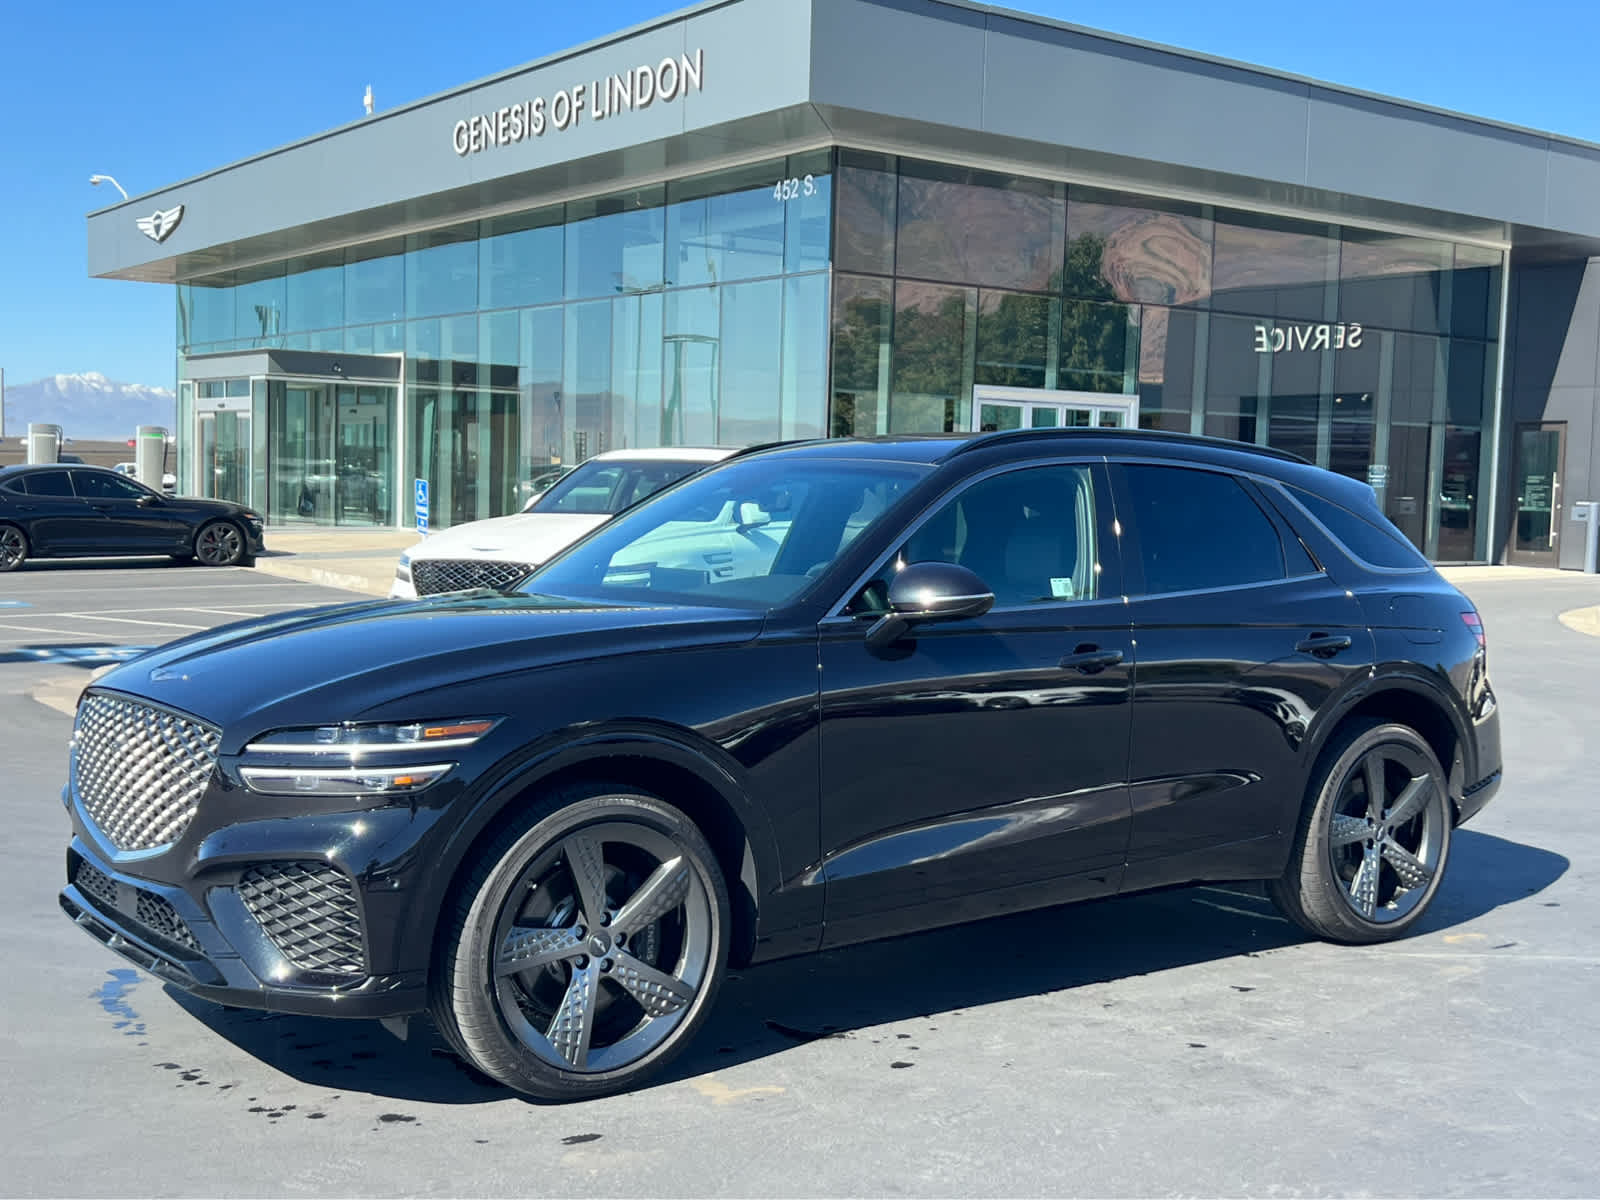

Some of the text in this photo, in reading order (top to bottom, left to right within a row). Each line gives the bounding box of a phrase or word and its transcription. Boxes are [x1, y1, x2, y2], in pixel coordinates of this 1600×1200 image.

[453, 48, 703, 156] GENESIS OF LINDON
[773, 174, 817, 201] 452 S.
